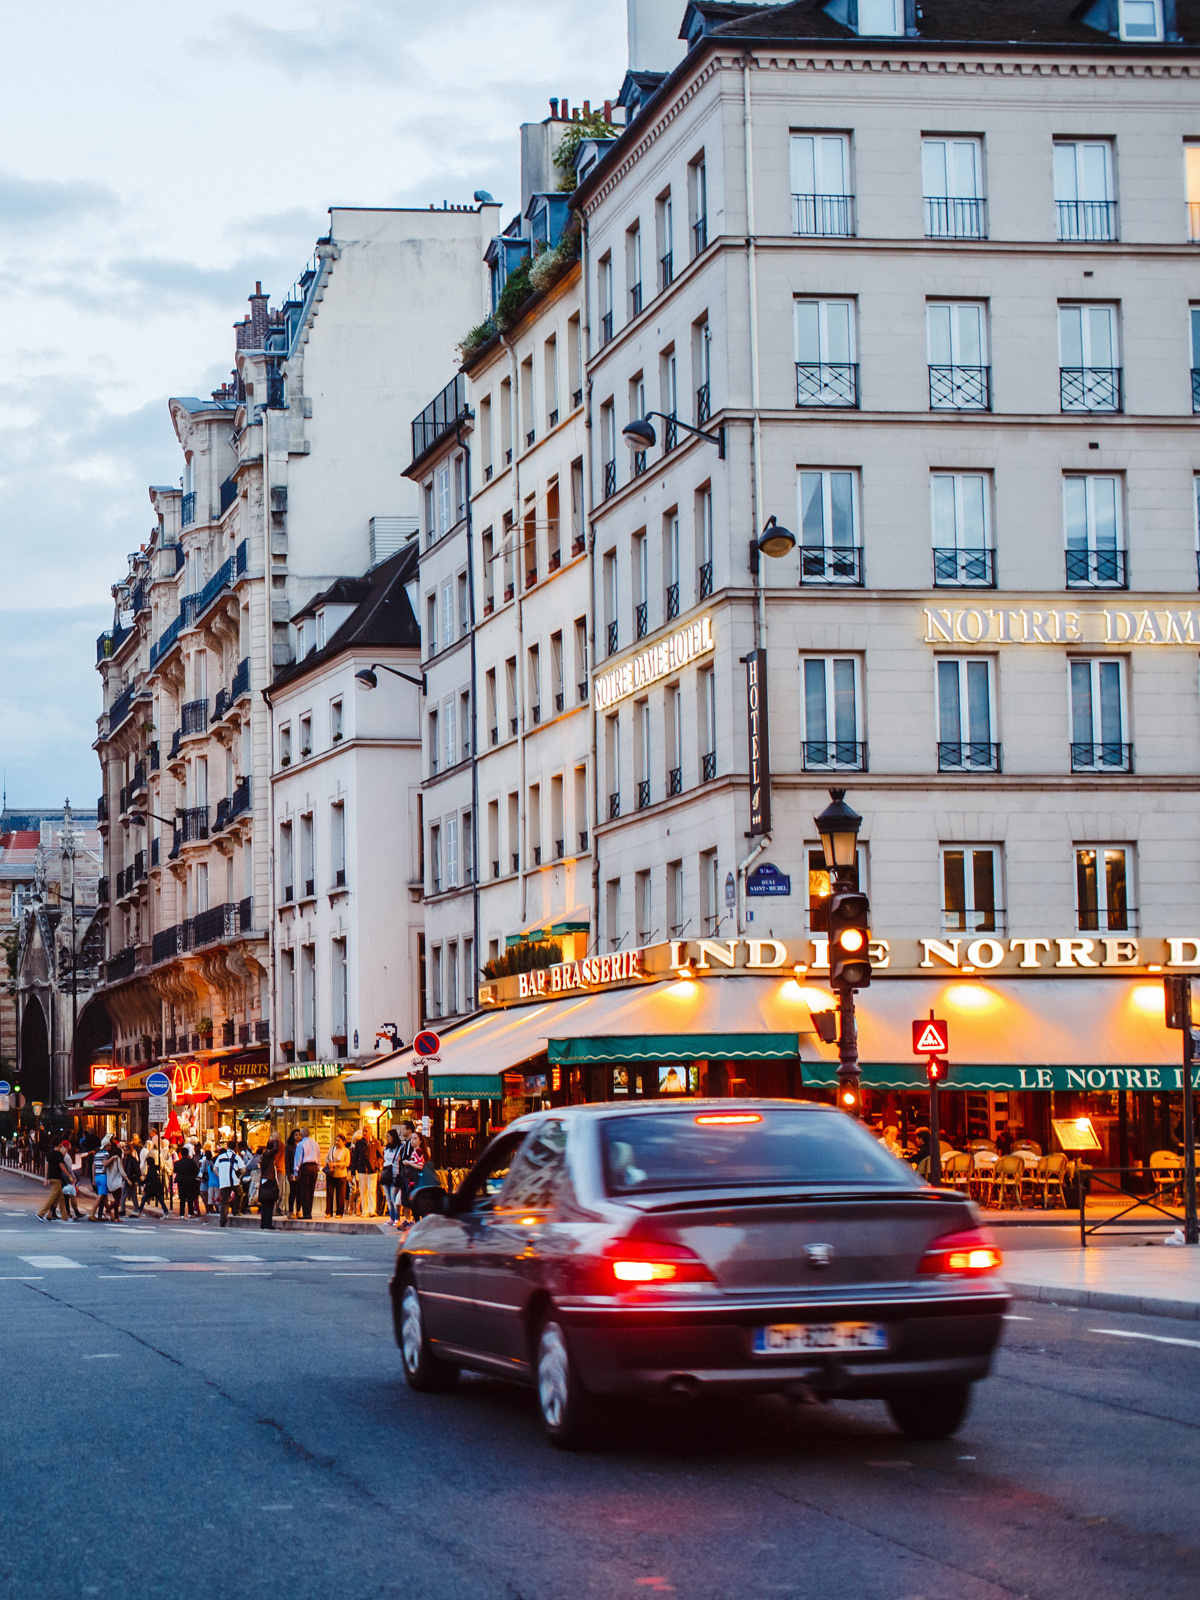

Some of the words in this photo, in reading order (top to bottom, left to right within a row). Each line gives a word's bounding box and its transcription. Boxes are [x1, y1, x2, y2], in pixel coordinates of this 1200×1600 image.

[924, 608, 1083, 644] NOTRE
[594, 662, 633, 711] NOTRE
[634, 644, 666, 688] DAME
[668, 617, 715, 669] HOTEL
[749, 661, 760, 784] HOTEL
[518, 969, 546, 998] BAR
[551, 949, 640, 992] BRASSERIE
[919, 938, 1139, 968] NOTRE
[1018, 1068, 1054, 1089] LE
[1065, 1068, 1162, 1089] NOTRE
